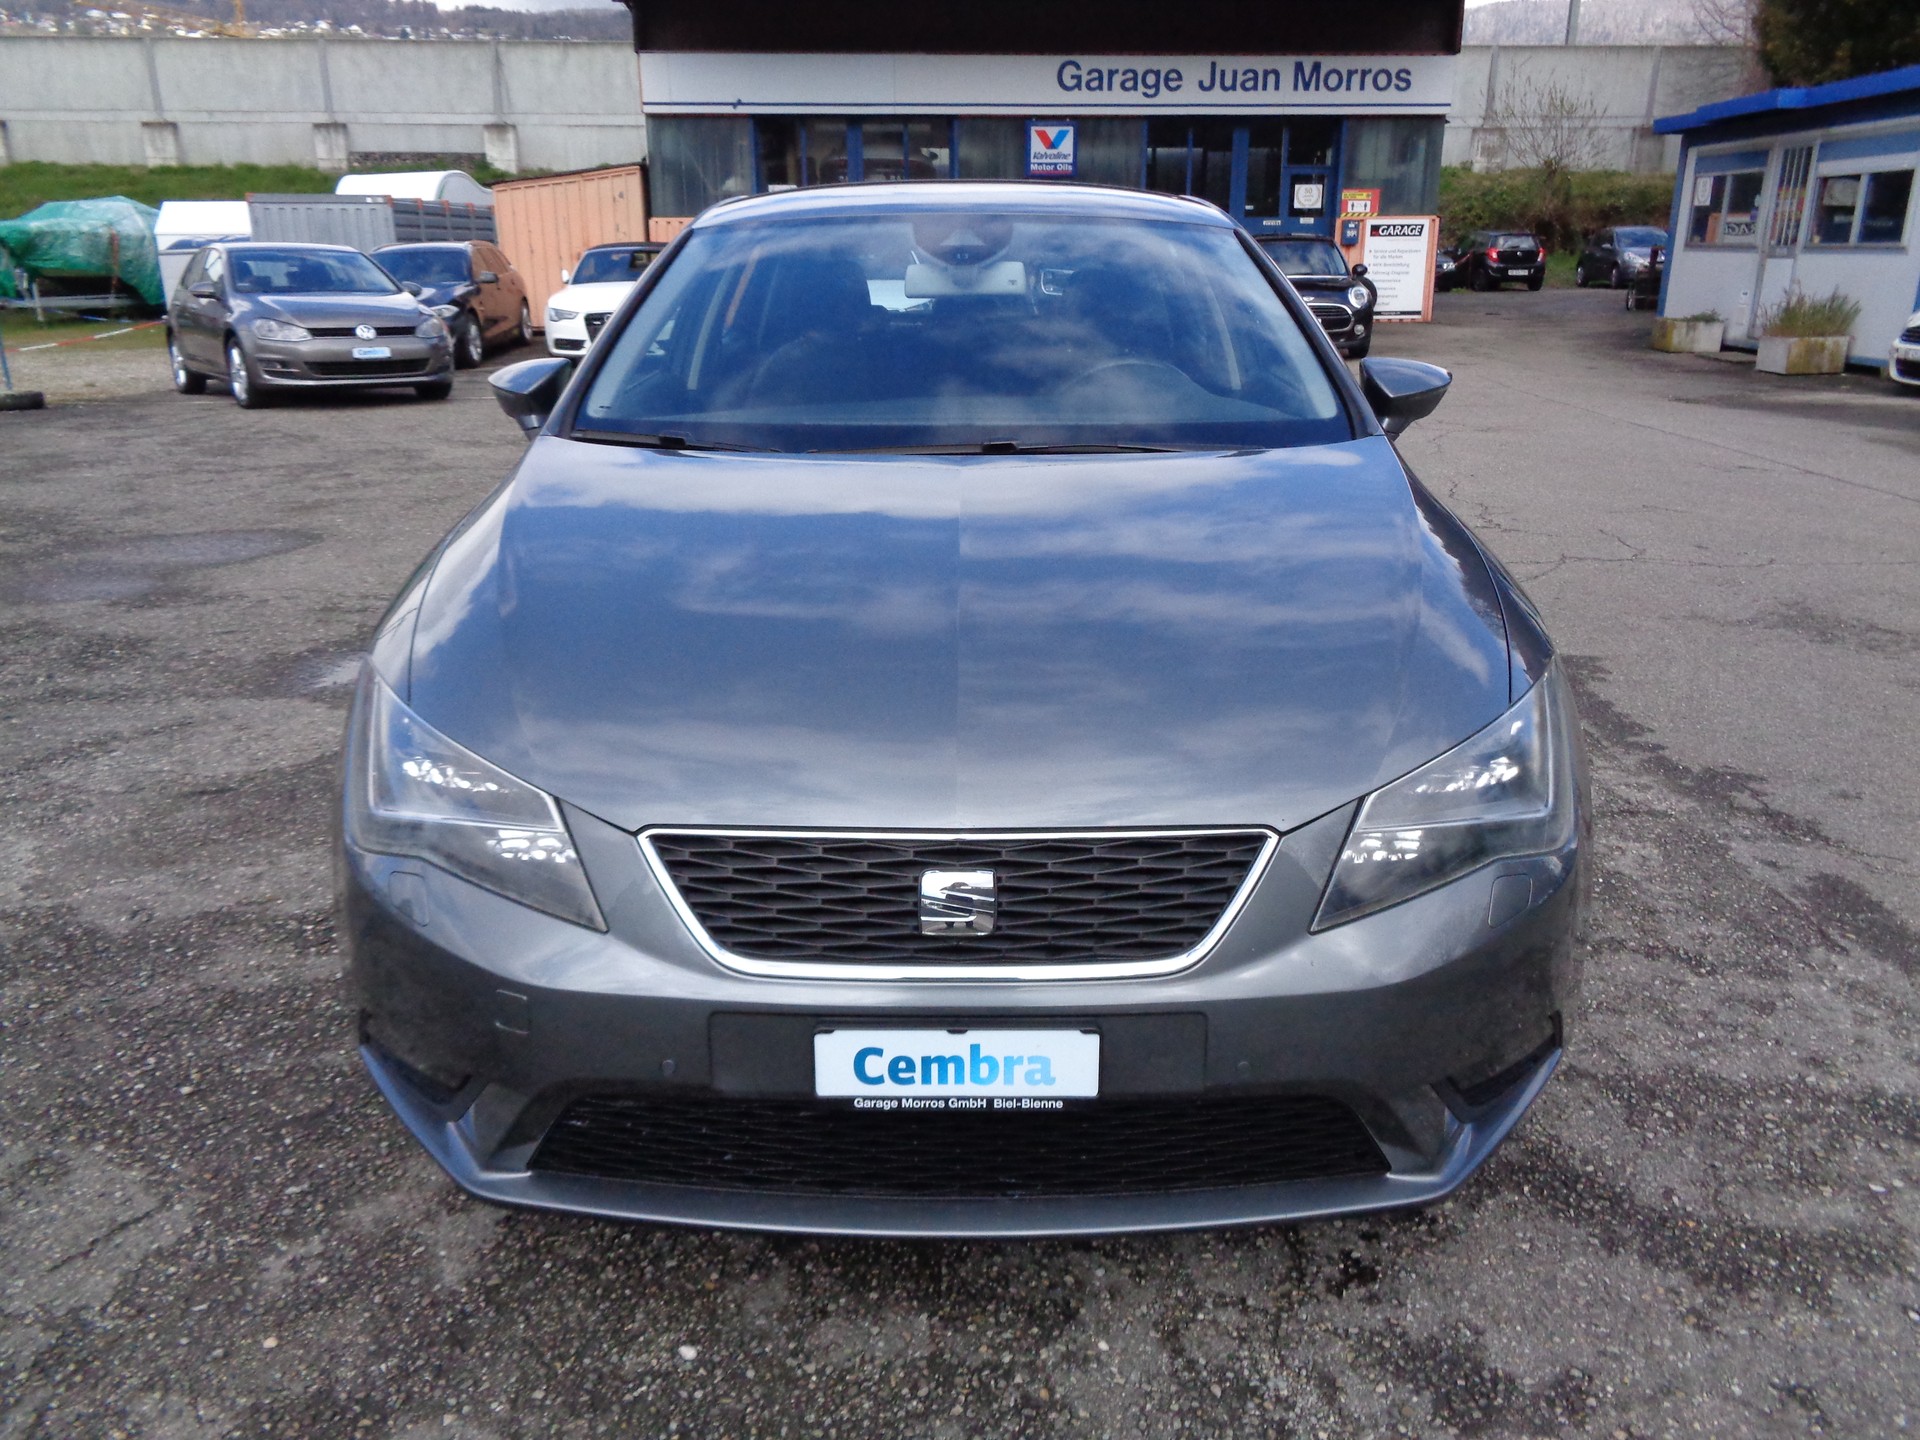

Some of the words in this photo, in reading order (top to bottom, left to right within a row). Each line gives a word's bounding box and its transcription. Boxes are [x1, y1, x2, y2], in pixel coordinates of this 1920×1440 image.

[1056, 59, 1184, 99] Garage
[1198, 60, 1281, 93] Juan
[1292, 60, 1412, 93] Morros
[1030, 163, 1055, 171] Motor
[1056, 163, 1073, 171] Oils
[853, 1043, 1057, 1086] Cembra
[853, 1097, 899, 1110] Garage
[901, 1097, 946, 1109] Morros
[948, 1097, 987, 1109] GmbH
[993, 1097, 1064, 1109] Biel-Bienne
